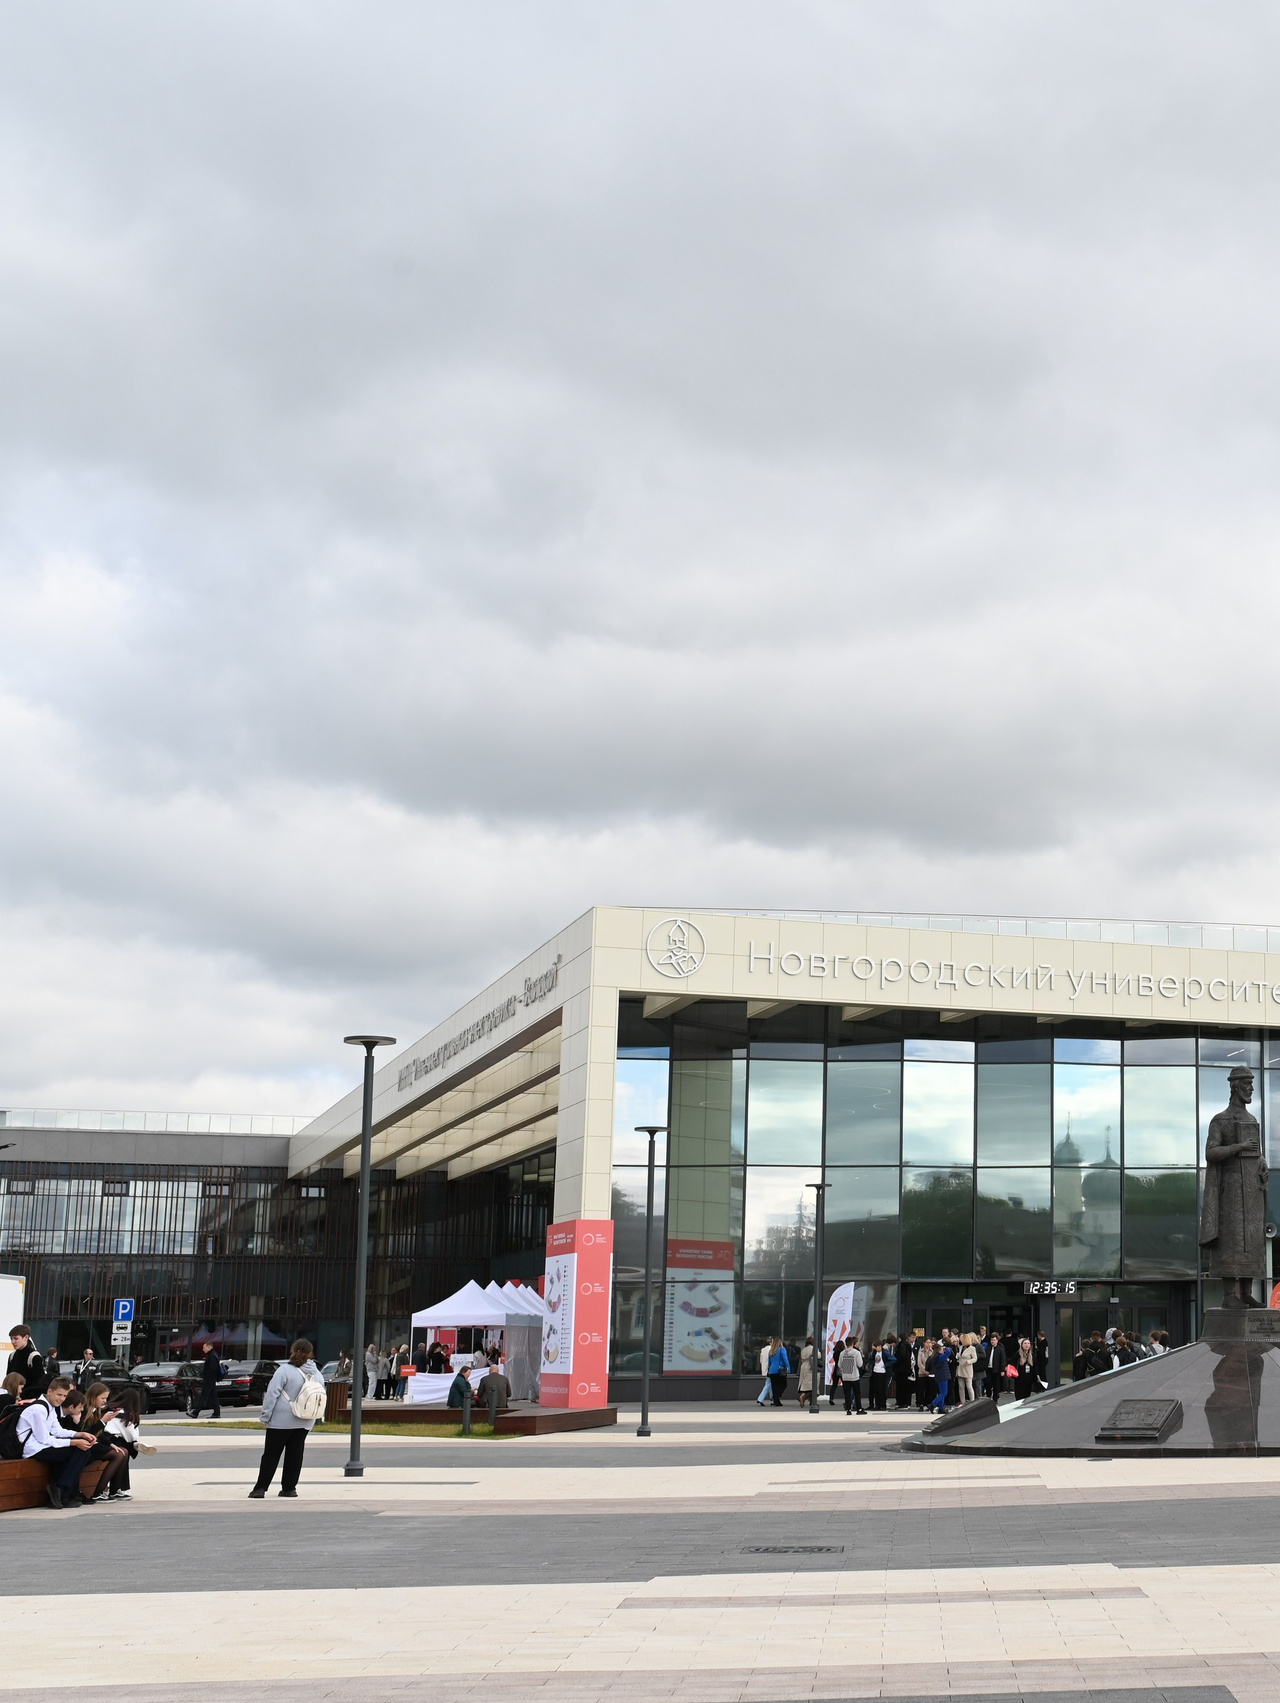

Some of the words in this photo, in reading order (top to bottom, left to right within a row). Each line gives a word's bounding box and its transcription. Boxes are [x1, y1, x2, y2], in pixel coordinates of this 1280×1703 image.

[749, 940, 1055, 990] Новгородский
[1029, 1281, 1076, 1294] 12:35:15
[118, 1301, 131, 1320] P
